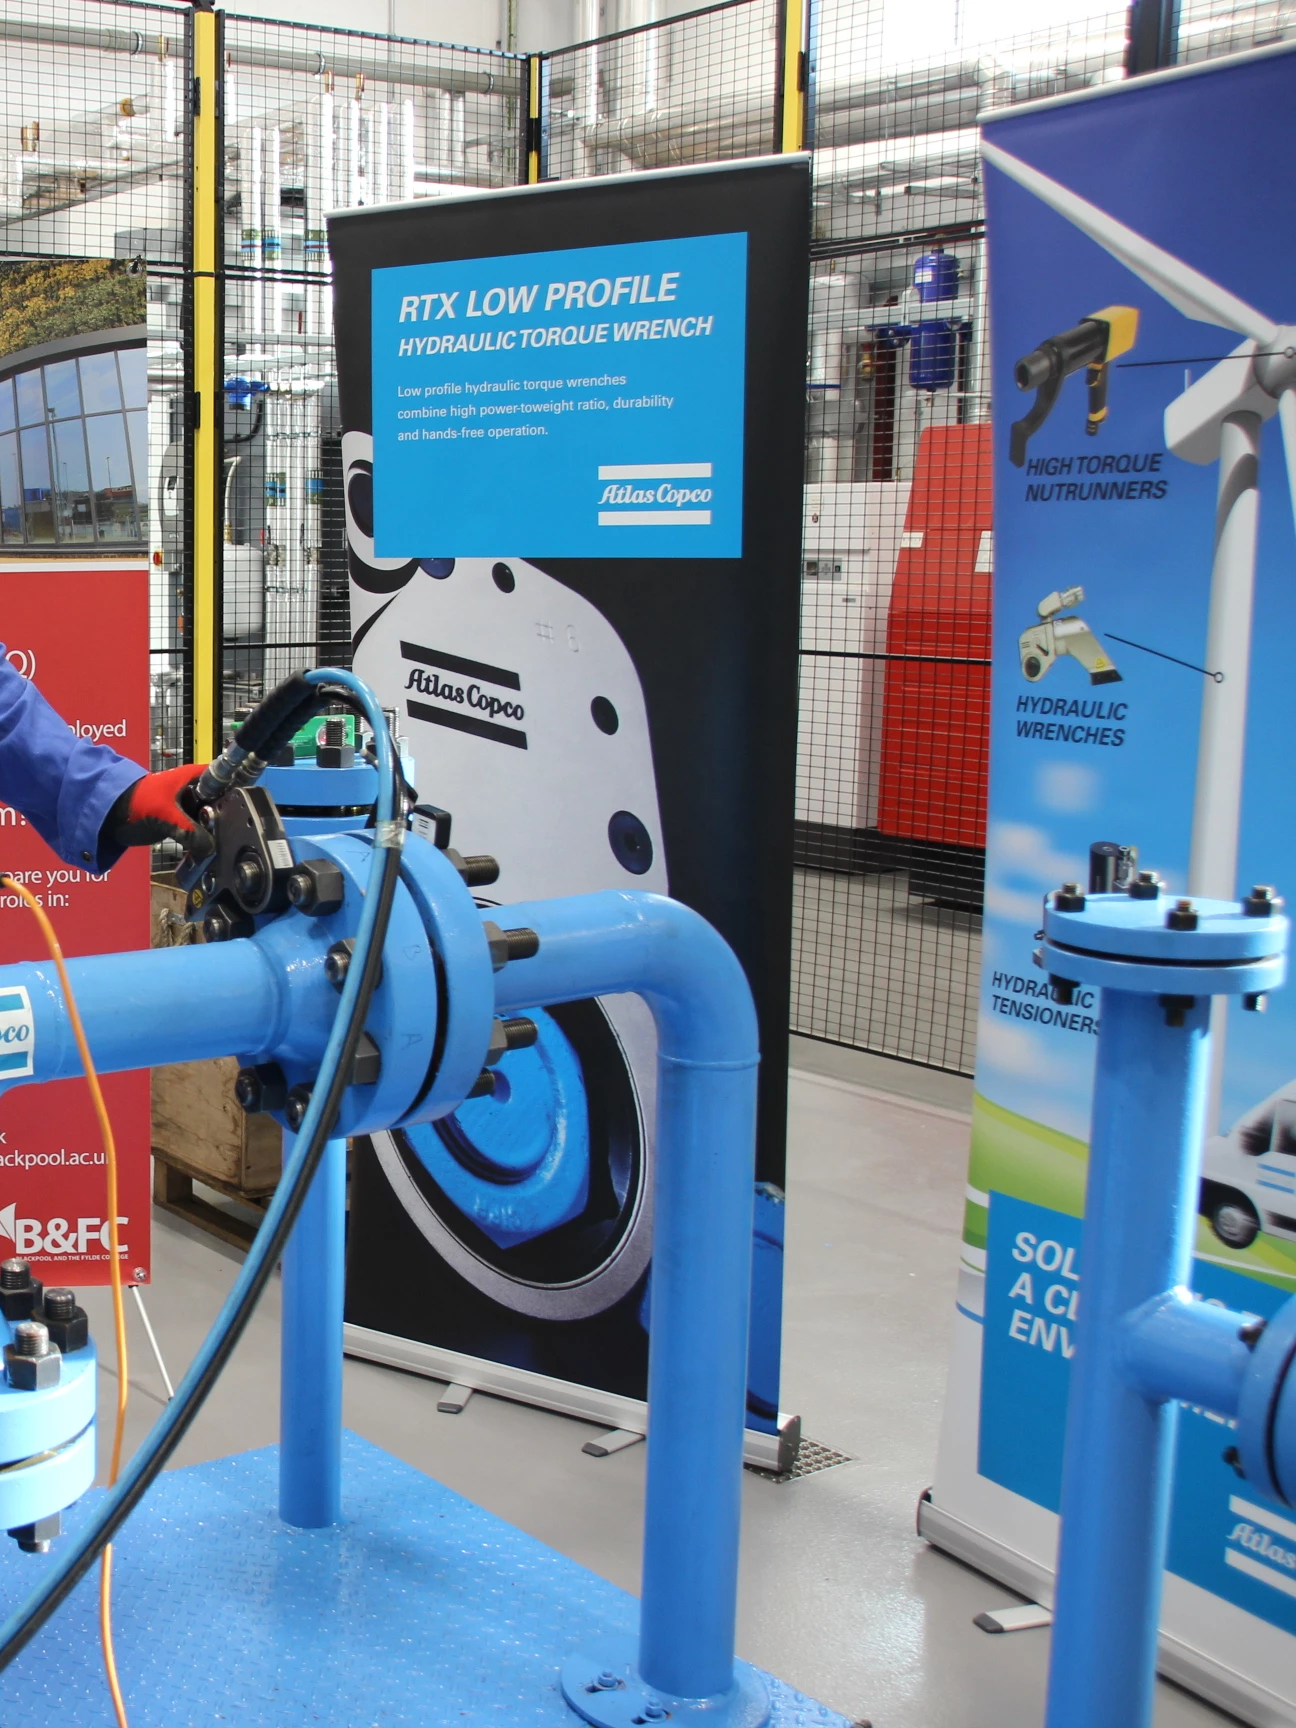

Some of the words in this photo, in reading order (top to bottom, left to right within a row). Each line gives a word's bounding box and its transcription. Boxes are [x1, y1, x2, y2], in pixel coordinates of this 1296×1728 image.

[398, 291, 459, 324] RTX
[465, 285, 539, 318] LOW
[544, 271, 680, 312] PROFILE
[397, 330, 517, 357] HYDRAULIC
[519, 323, 609, 349] TORQUE
[612, 315, 714, 343] WRENCH
[397, 385, 422, 398] Low
[424, 383, 462, 399] profile
[465, 380, 520, 395] hydraulic
[523, 379, 563, 392] torque
[566, 374, 627, 388] wrenches
[397, 406, 447, 419] combine
[450, 404, 476, 419] high
[480, 399, 574, 418] power-toweight
[577, 397, 610, 411] ratio,
[613, 394, 674, 410] durability
[397, 429, 419, 441] and
[422, 427, 484, 440] hands-free
[488, 424, 549, 440] operation.
[1025, 456, 1073, 477] HIGH
[1076, 453, 1164, 475] TORQUE
[597, 484, 655, 505] Atlas
[656, 483, 713, 507] Copco
[1025, 480, 1168, 502] NUTRUNNERS
[404, 668, 465, 704] Atlas
[467, 684, 525, 721] Copco
[1016, 695, 1128, 721] HYDRAULIC
[1016, 720, 1126, 747] WRENCHES
[46, 869, 81, 888] you
[48, 890, 70, 907] in:
[992, 971, 1095, 1009] HYDRAIC
[15, 1216, 129, 1254] B&FC
[1008, 1272, 1034, 1305] A
[1225, 1522, 1296, 1570] Atlas
